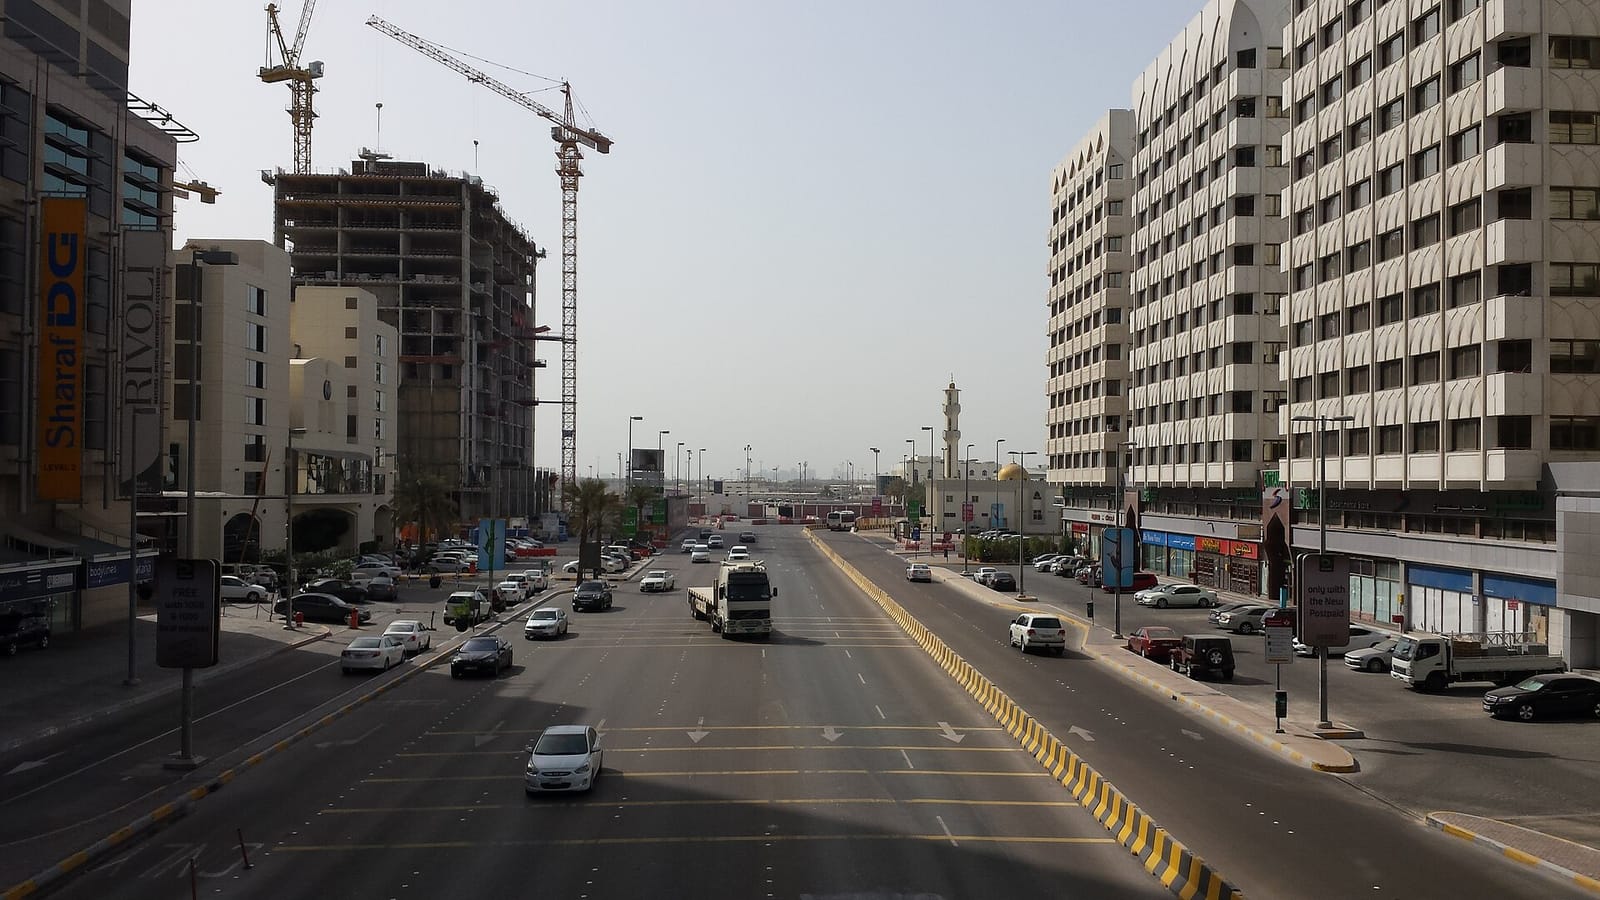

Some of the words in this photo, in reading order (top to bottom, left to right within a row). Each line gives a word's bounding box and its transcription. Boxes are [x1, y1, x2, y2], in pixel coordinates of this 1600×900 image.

[47, 232, 78, 327] DG
[124, 266, 154, 405] RIVOLI
[46, 335, 77, 448] Sharaf
[172, 588, 200, 597] FREE
[1307, 585, 1326, 595] only
[1327, 585, 1345, 594] with
[1309, 597, 1323, 605] the
[1325, 597, 1344, 605] New
[1309, 609, 1345, 618] Postpaid
